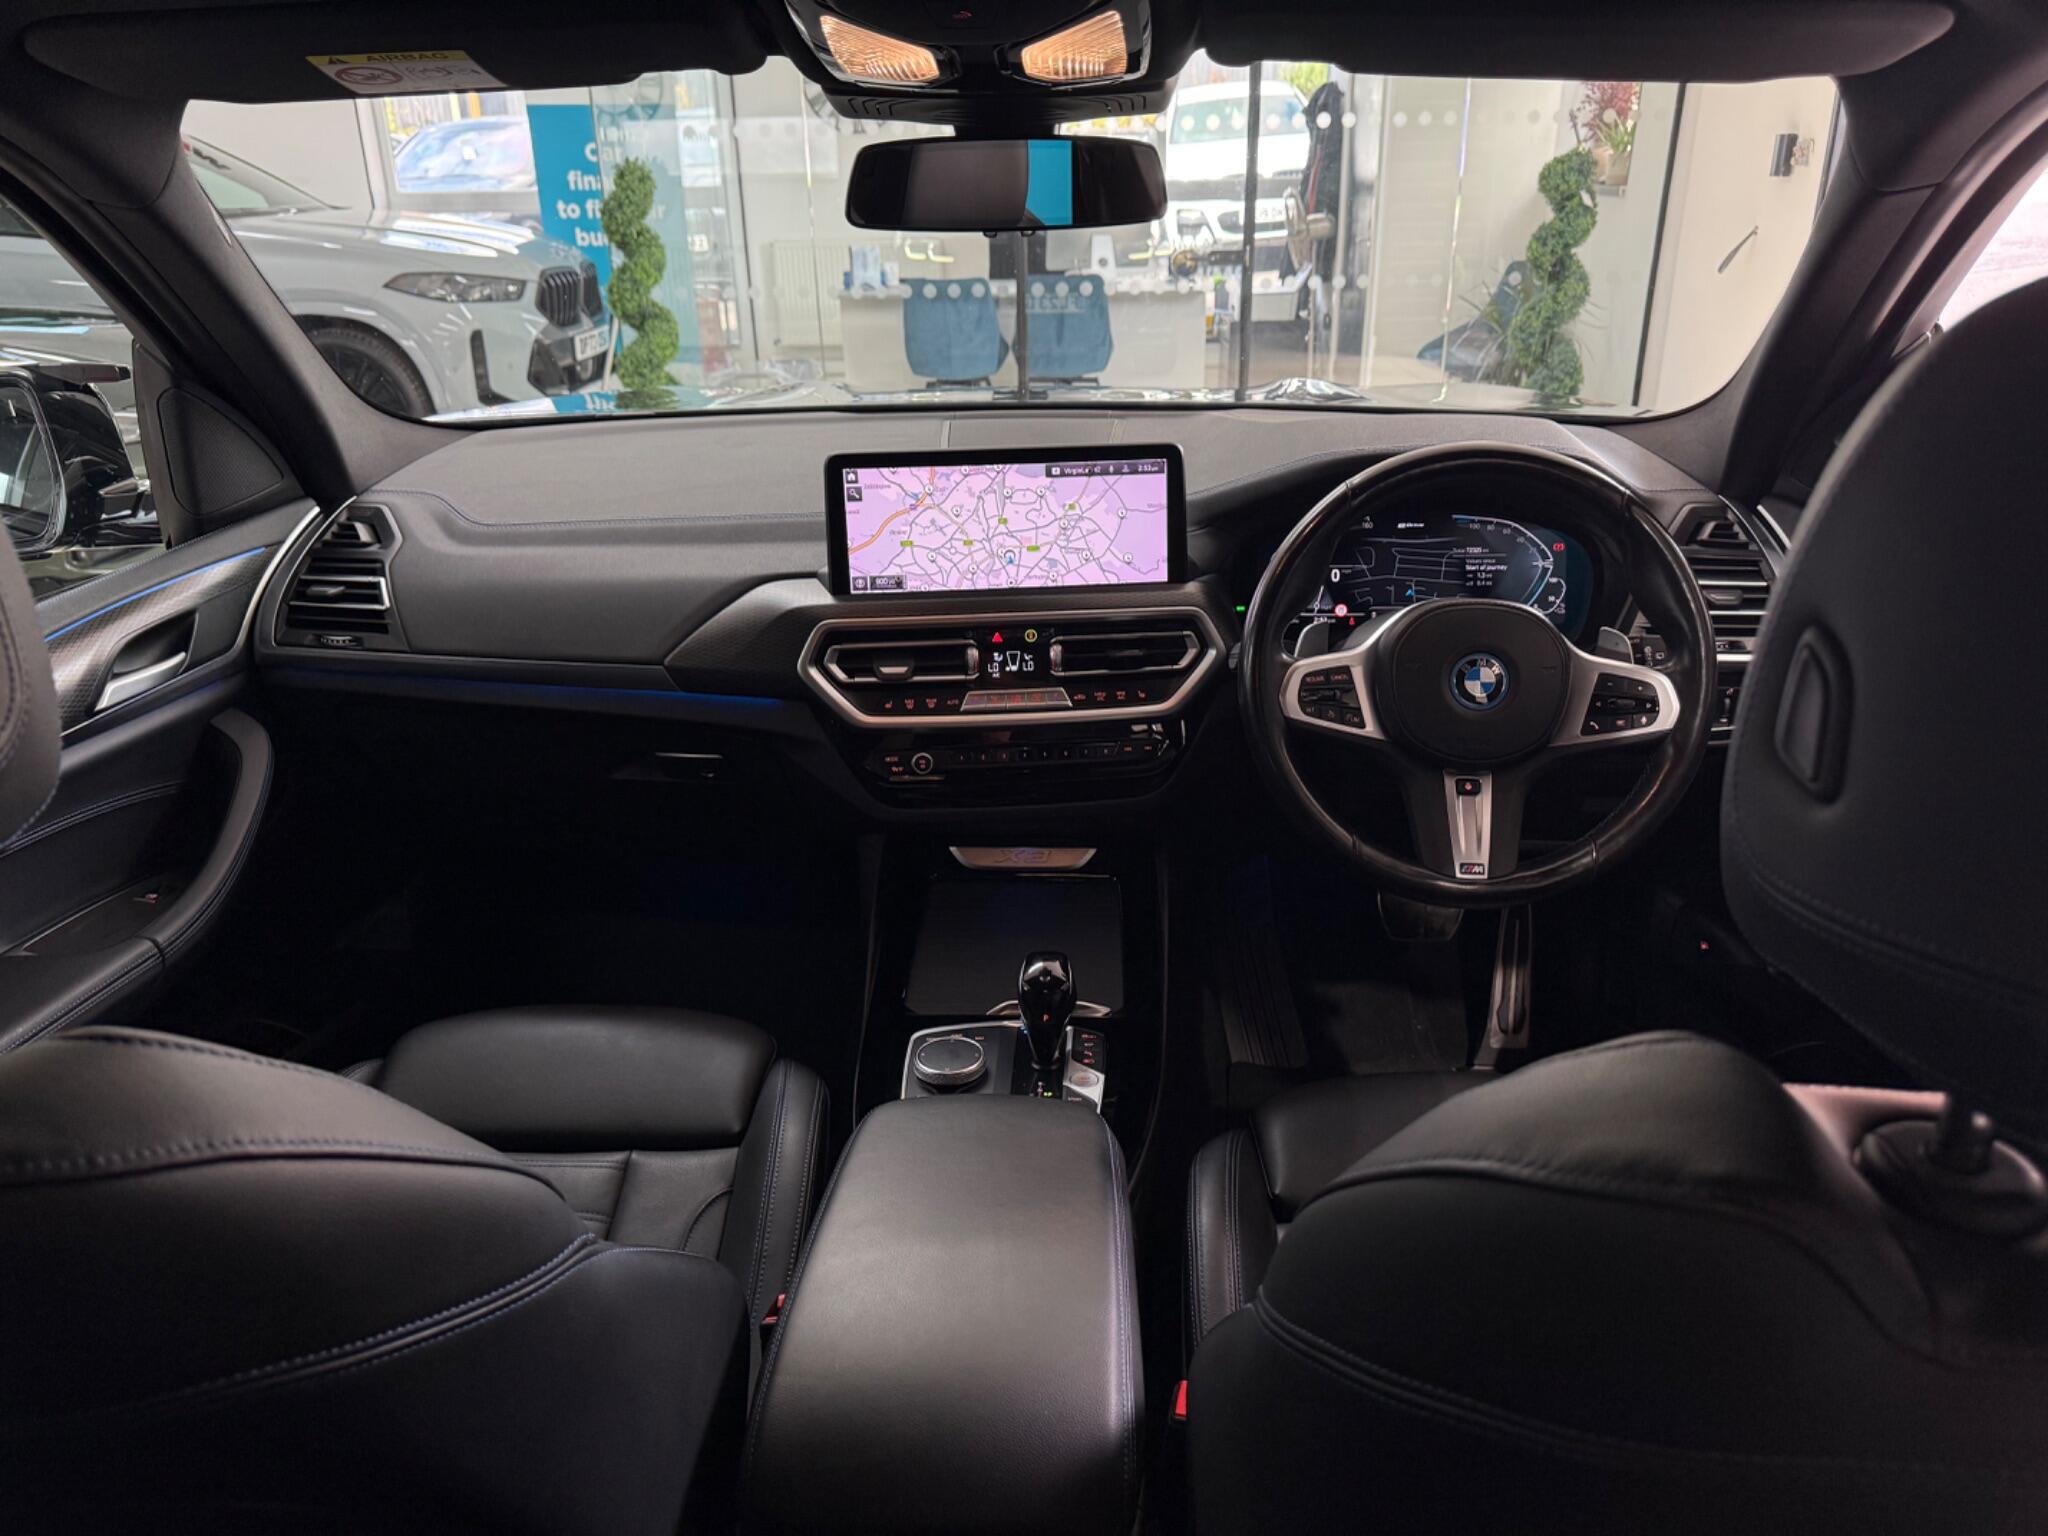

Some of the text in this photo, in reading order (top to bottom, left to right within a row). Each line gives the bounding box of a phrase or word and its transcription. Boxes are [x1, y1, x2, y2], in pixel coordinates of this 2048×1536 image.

[367, 53, 449, 62] AIRBAG
[557, 201, 581, 219] to
[1331, 568, 1340, 582] 0
